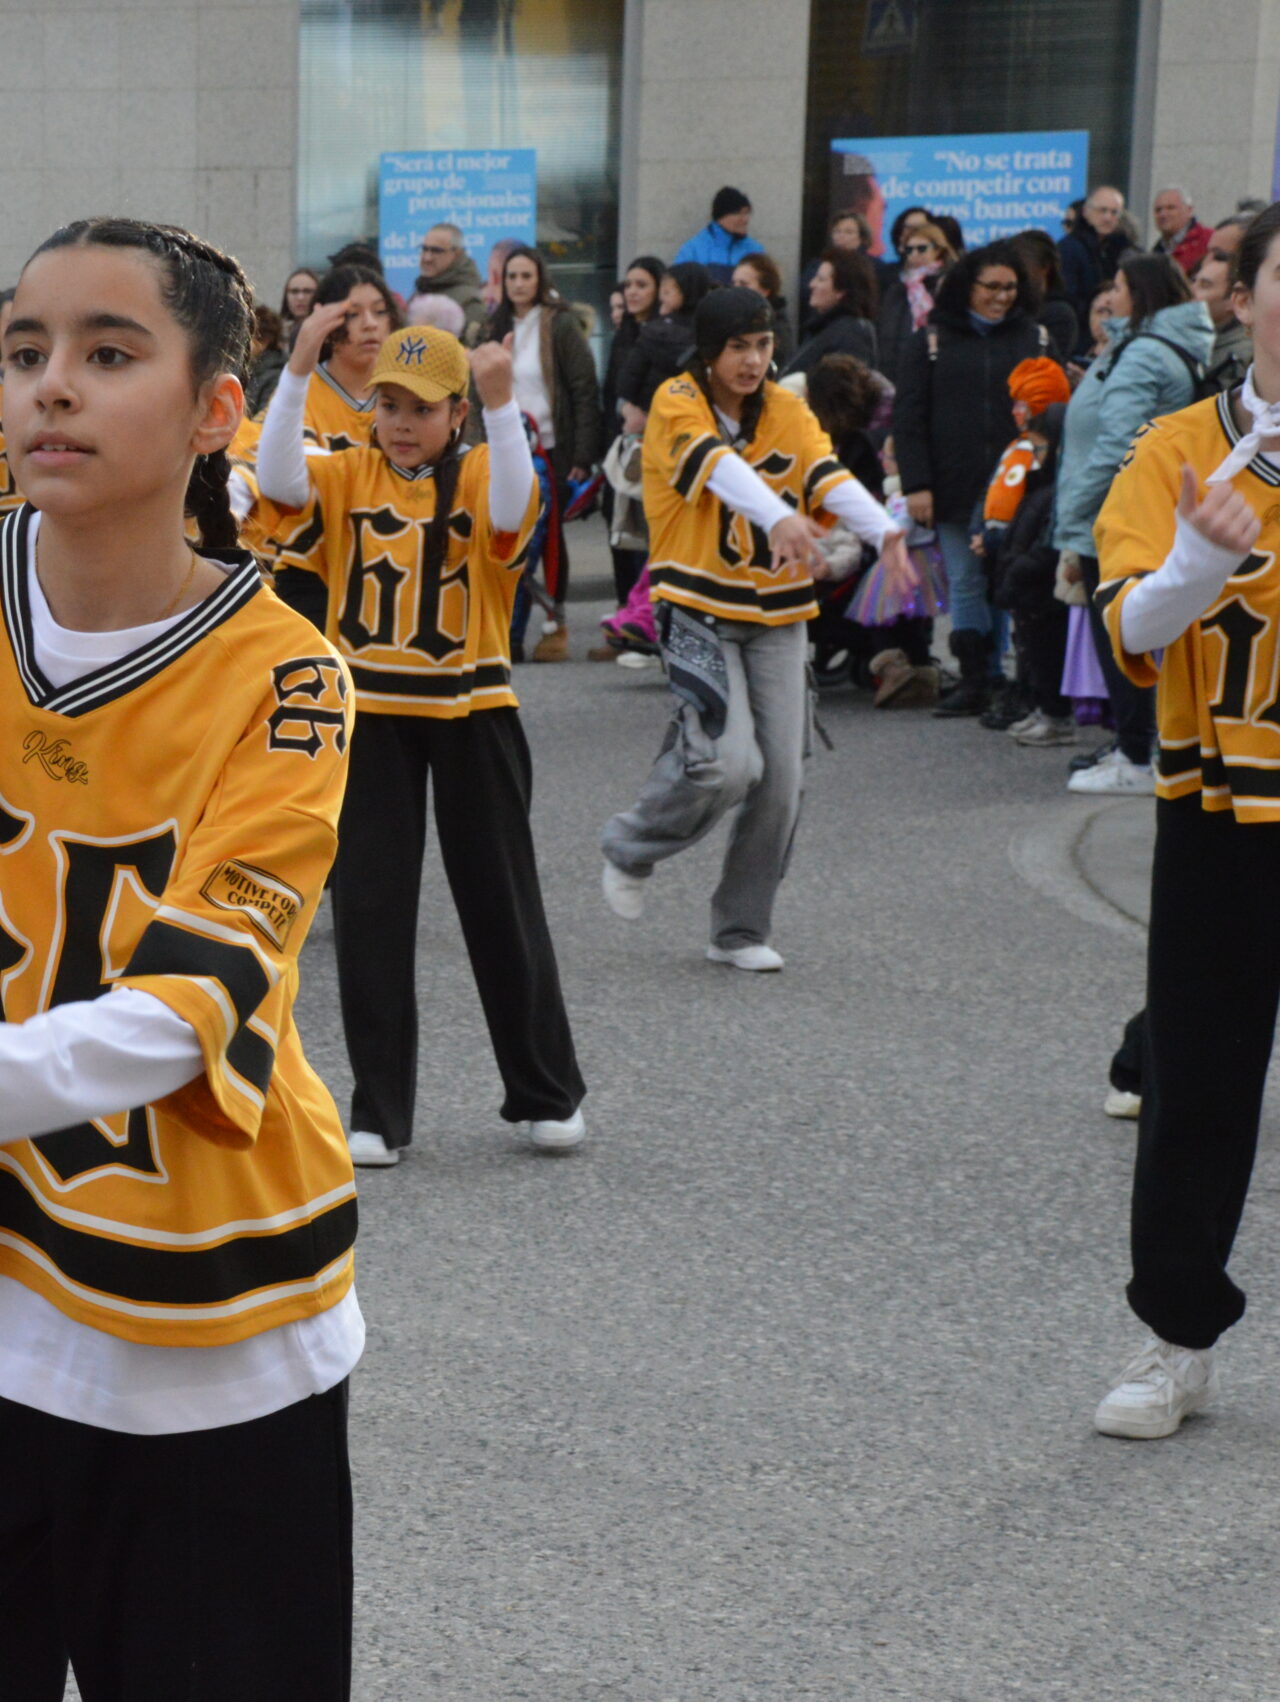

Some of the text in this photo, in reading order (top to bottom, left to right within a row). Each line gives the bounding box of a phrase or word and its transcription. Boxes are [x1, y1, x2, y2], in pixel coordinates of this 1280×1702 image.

[457, 154, 511, 174] mejor
[985, 156, 1009, 171] se
[1014, 148, 1072, 170] trata
[914, 174, 1022, 201] competir
[1026, 174, 1072, 195] con
[408, 190, 531, 215] profesionales
[476, 211, 531, 227] sector
[223, 866, 271, 900] MOTIVE
